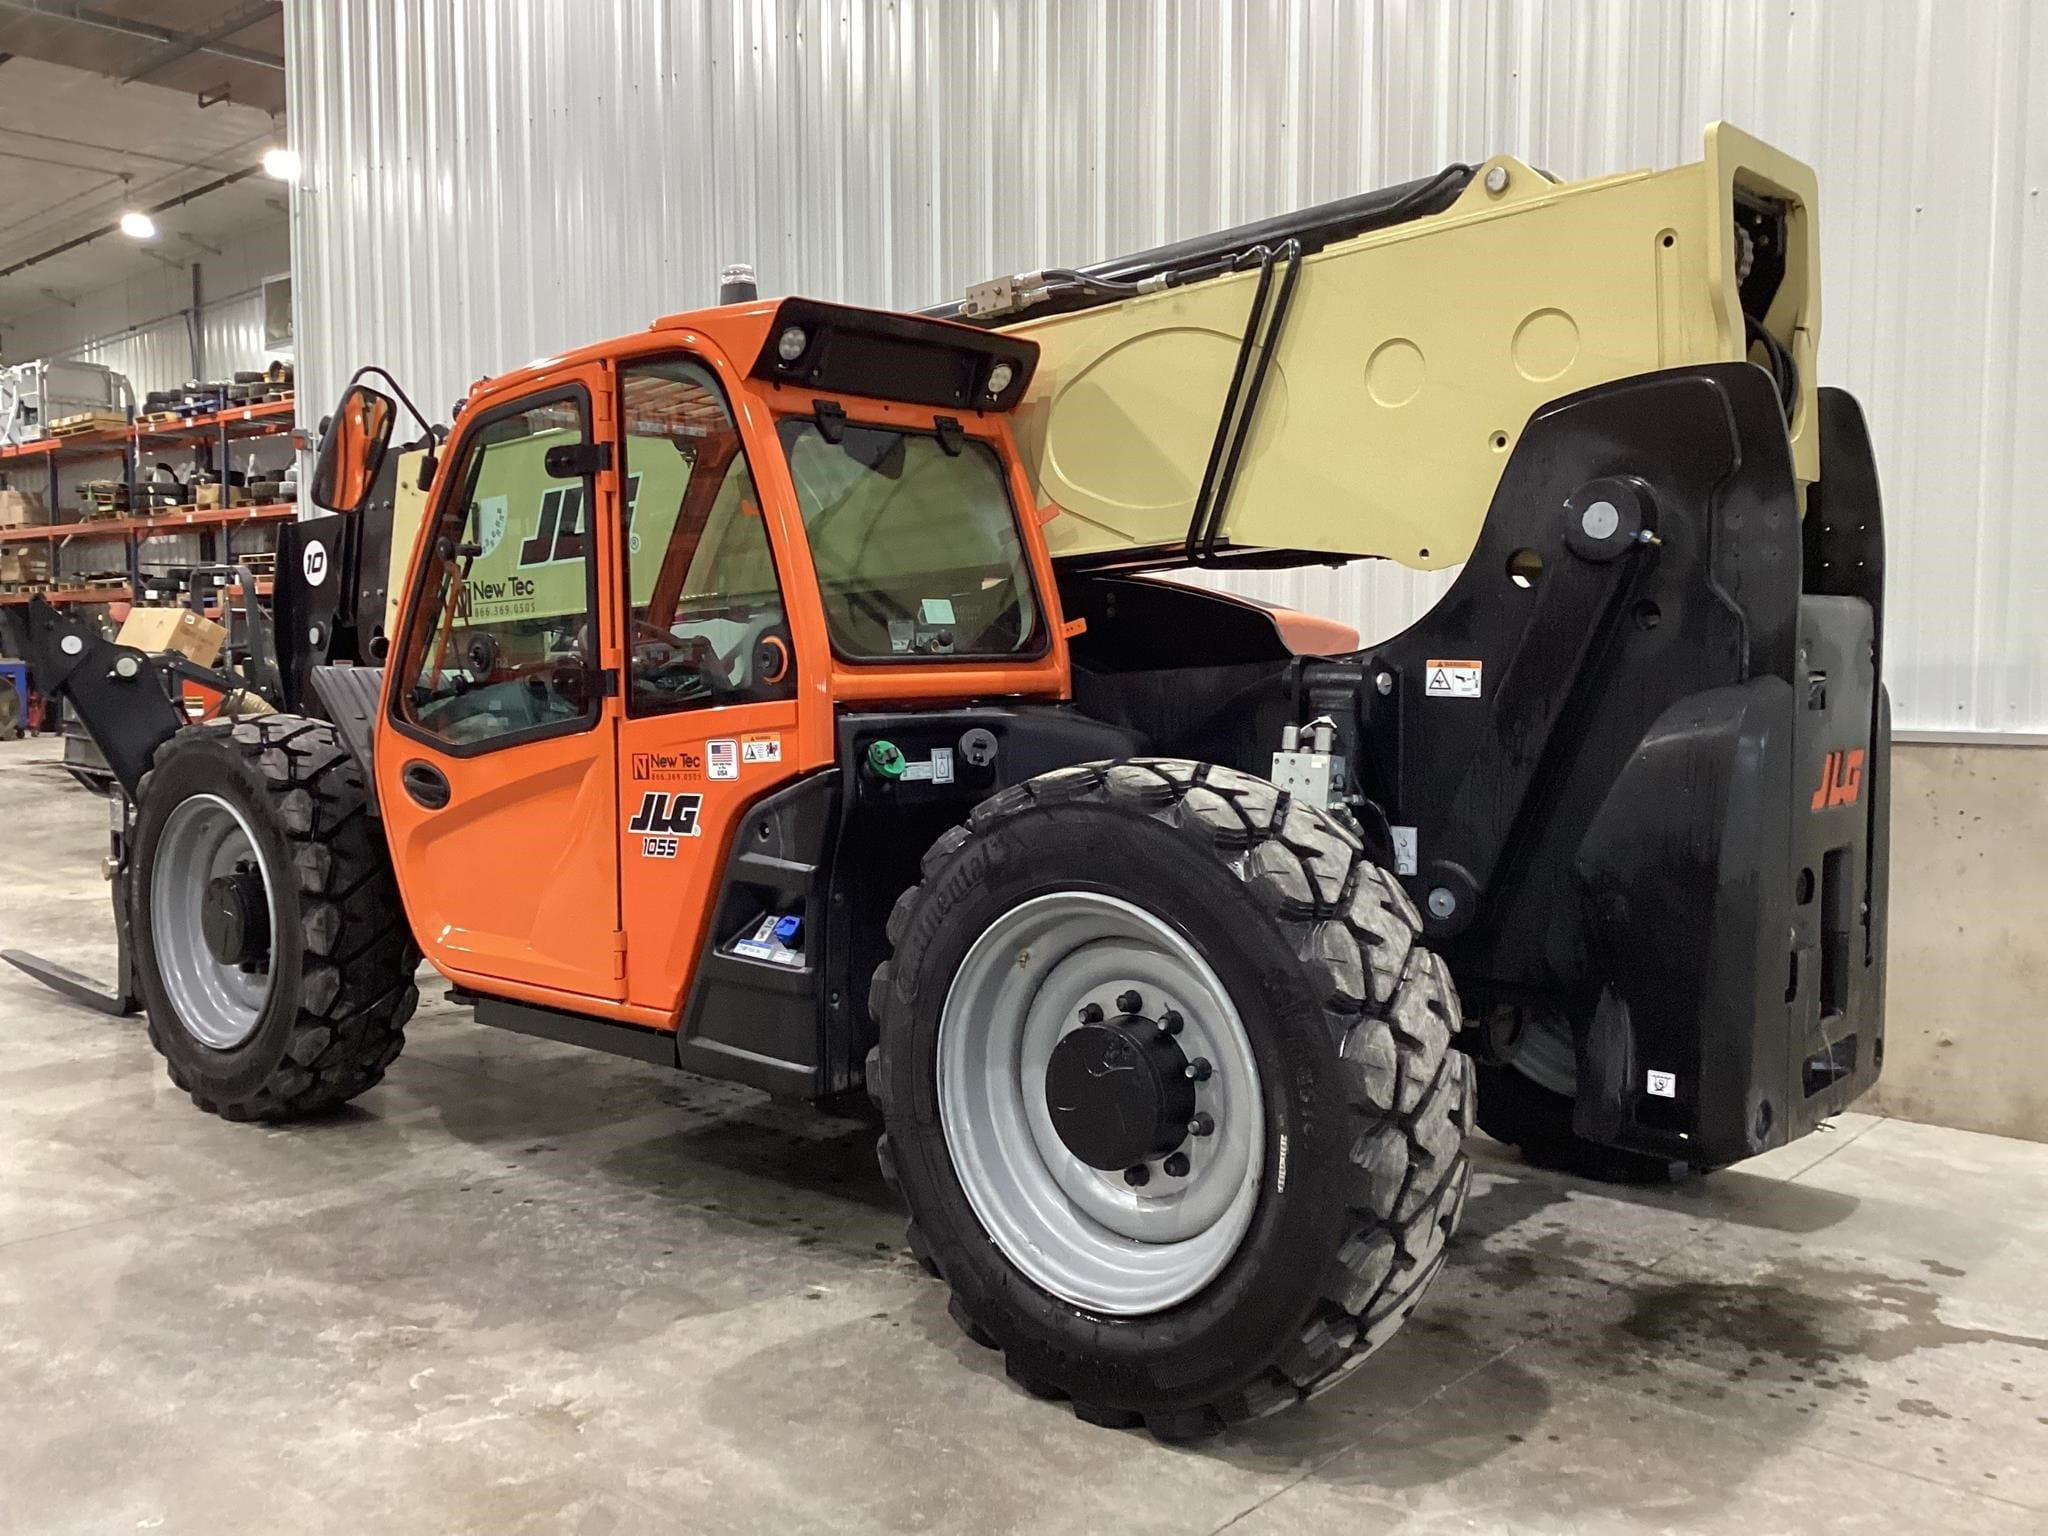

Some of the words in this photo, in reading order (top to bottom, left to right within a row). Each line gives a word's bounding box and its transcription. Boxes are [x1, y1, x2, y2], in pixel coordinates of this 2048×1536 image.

[518, 475, 640, 567] JL
[306, 551, 324, 575] 10
[473, 579, 505, 600] New
[508, 575, 535, 597] Tec
[650, 753, 678, 768] New
[679, 753, 701, 768] Tec
[1810, 748, 1865, 812] JLG
[630, 794, 701, 834] JLG
[643, 838, 677, 857] 1055
